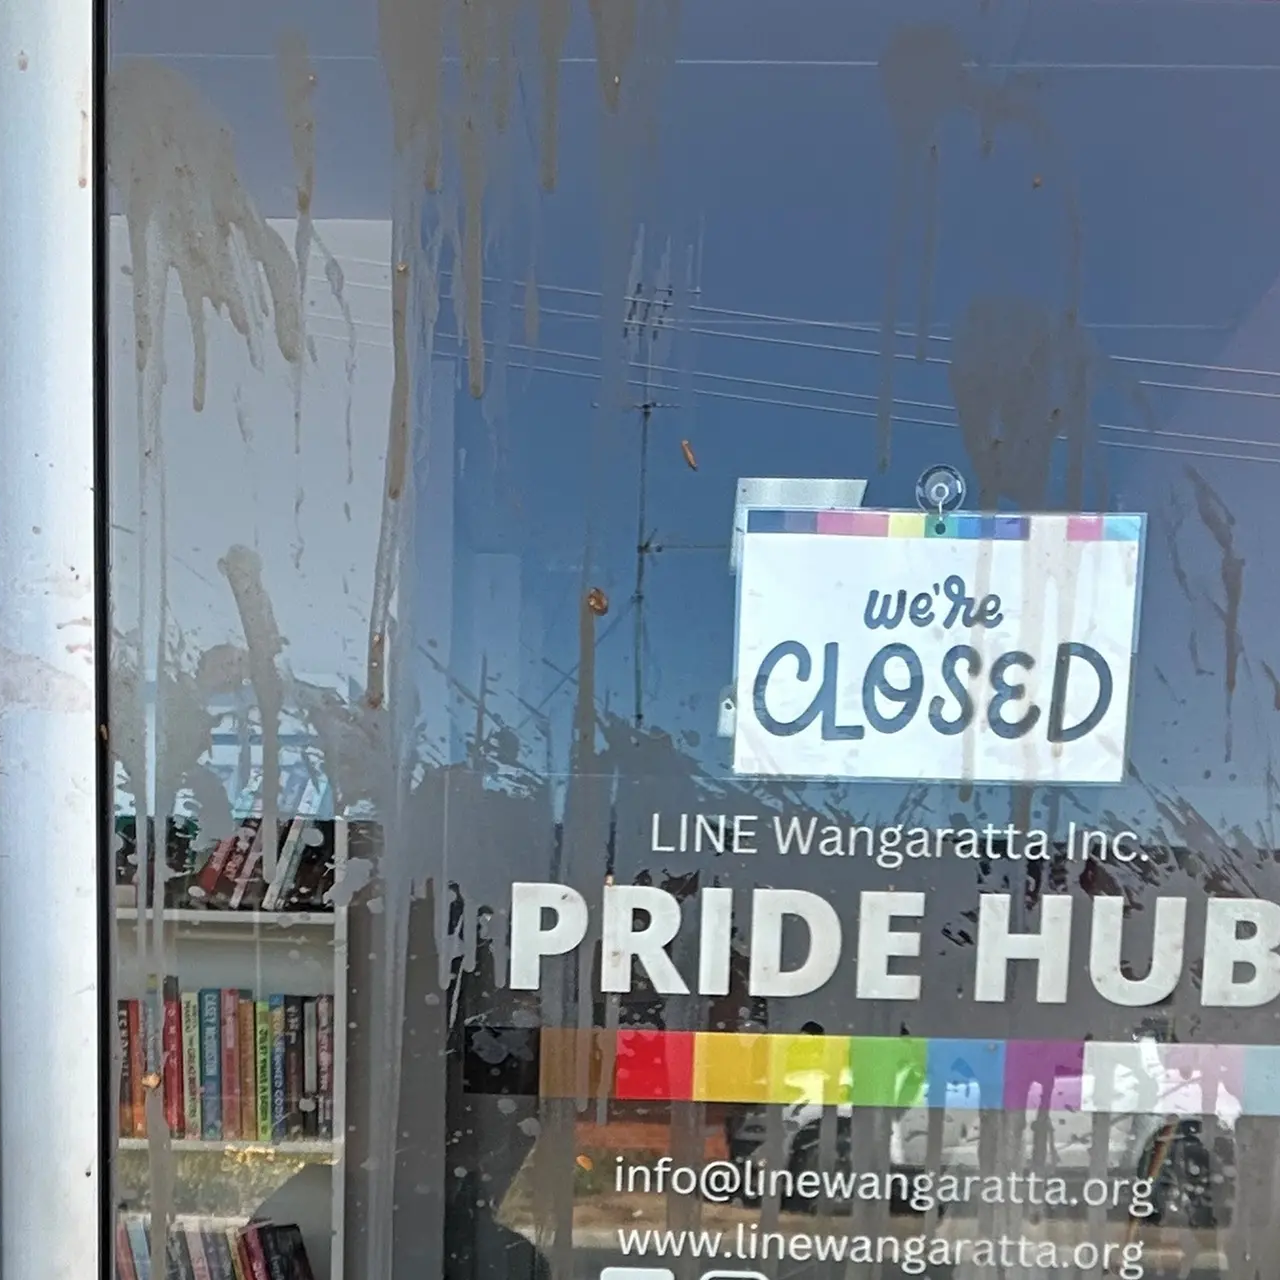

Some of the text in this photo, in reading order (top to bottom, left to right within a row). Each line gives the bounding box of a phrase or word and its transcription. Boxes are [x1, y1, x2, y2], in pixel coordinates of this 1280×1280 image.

[865, 574, 1005, 632] we're
[752, 639, 1114, 743] CLOSED
[650, 811, 1151, 872] LINE Wangaratta Inc.
[508, 881, 926, 1001] PRIDE
[614, 1156, 1155, 1217] info@linewangaratta.org
[617, 1223, 1146, 1279] www.linewangaratta.org
